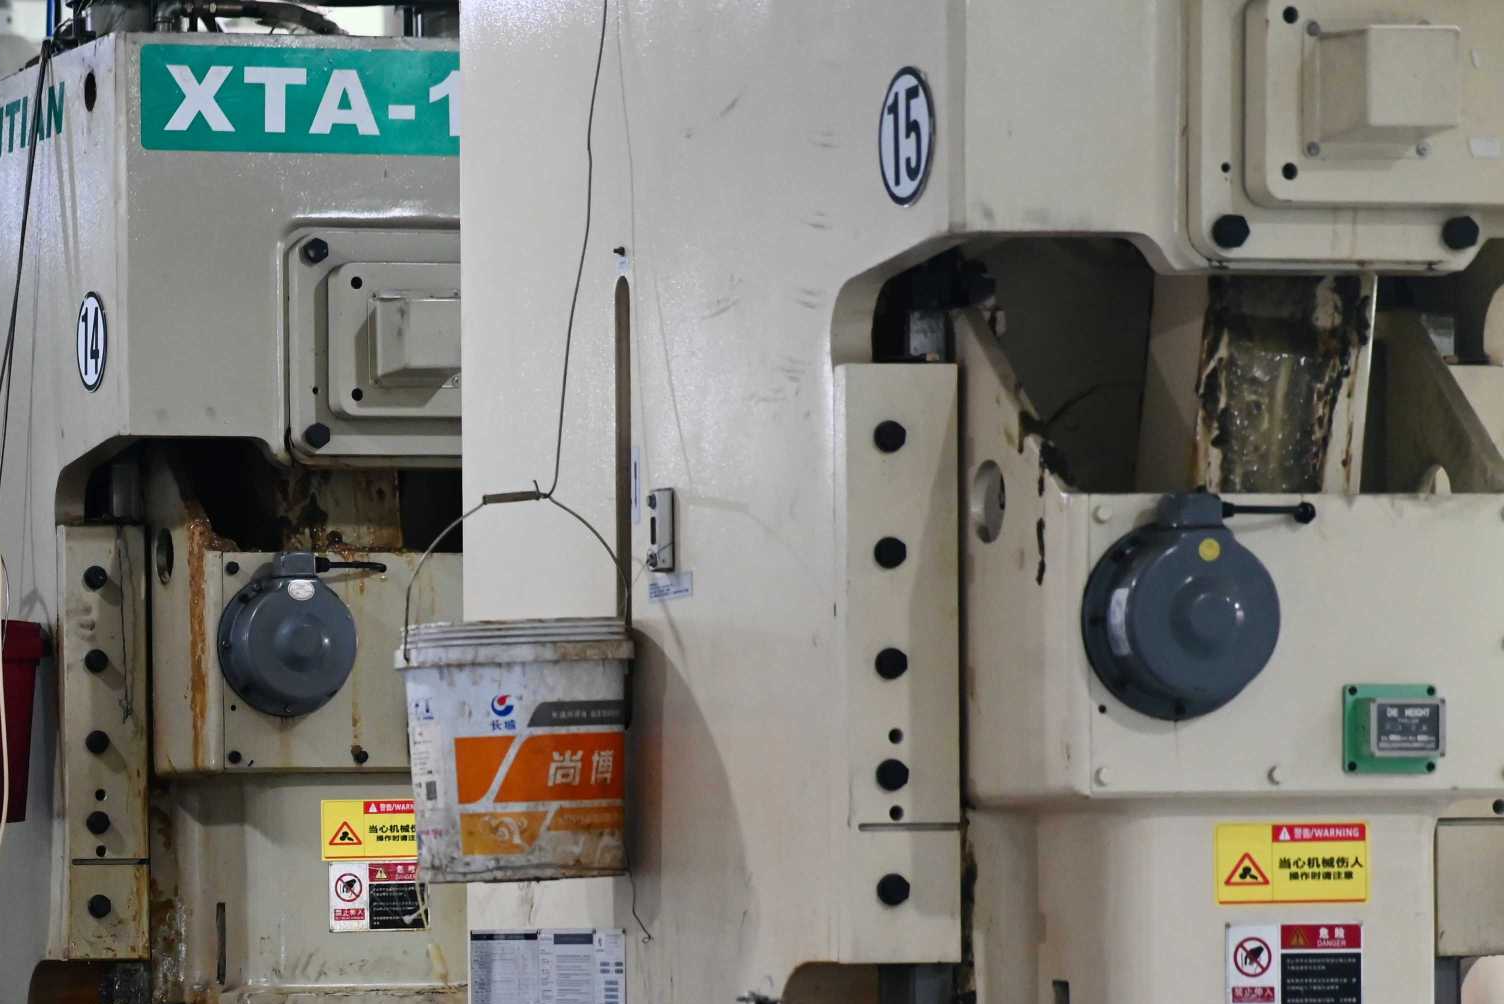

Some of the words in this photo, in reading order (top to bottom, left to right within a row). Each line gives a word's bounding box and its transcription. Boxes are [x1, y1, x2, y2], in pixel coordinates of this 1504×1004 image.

[163, 64, 460, 137] XTA-1
[887, 84, 922, 187] 15
[81, 306, 100, 376] 14
[547, 750, 614, 787] 尚博
[1279, 856, 1363, 869] 当心机械伤人
